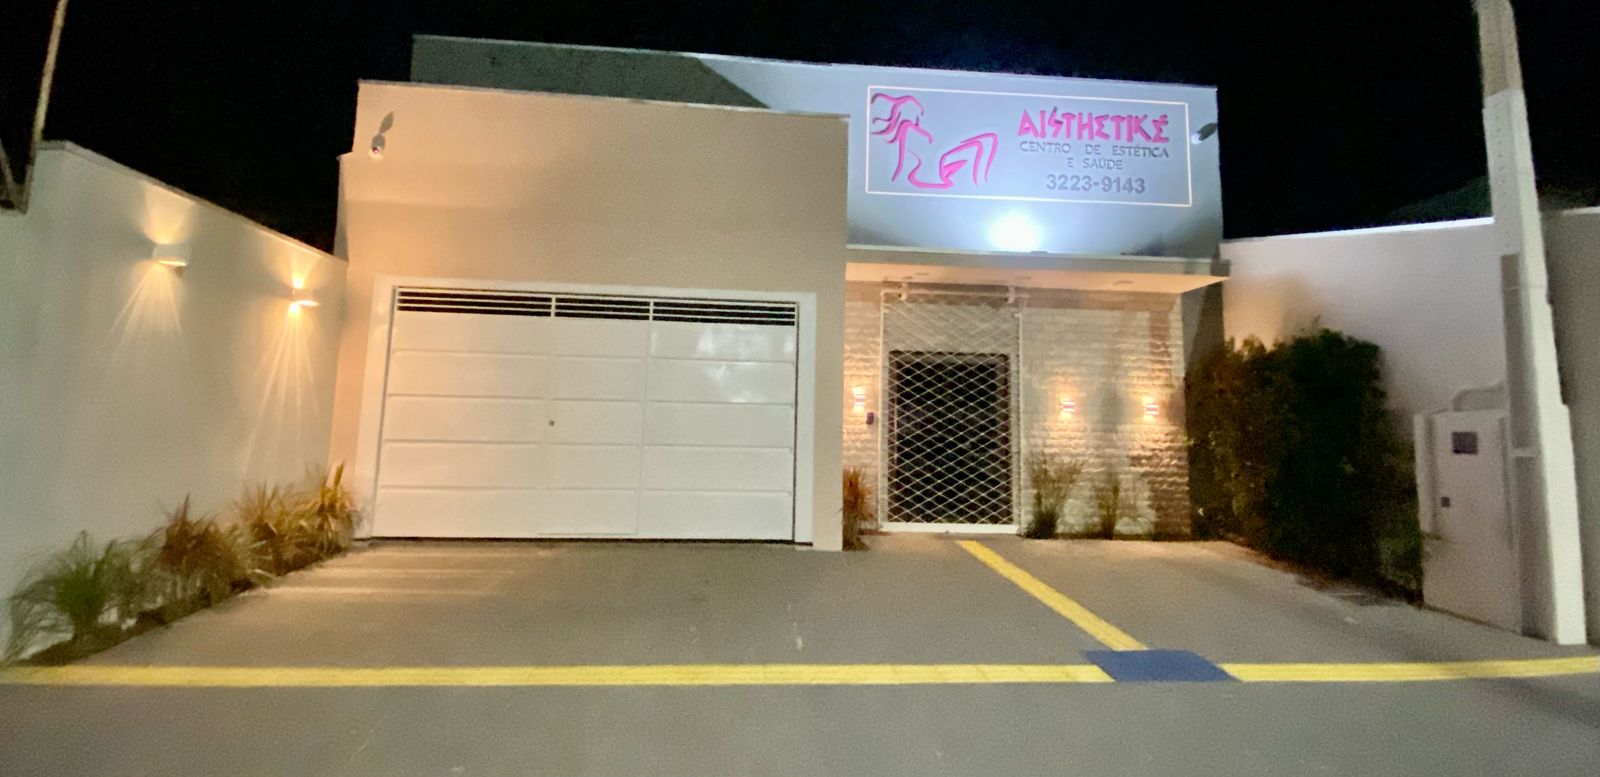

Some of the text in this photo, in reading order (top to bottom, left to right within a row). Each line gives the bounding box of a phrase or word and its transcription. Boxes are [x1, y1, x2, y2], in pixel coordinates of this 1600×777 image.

[1019, 141, 1170, 158] CENTRO DE ESTÉTICA
[1067, 157, 1123, 170] E SAÚDE
[1046, 174, 1146, 194] 3223-9143
